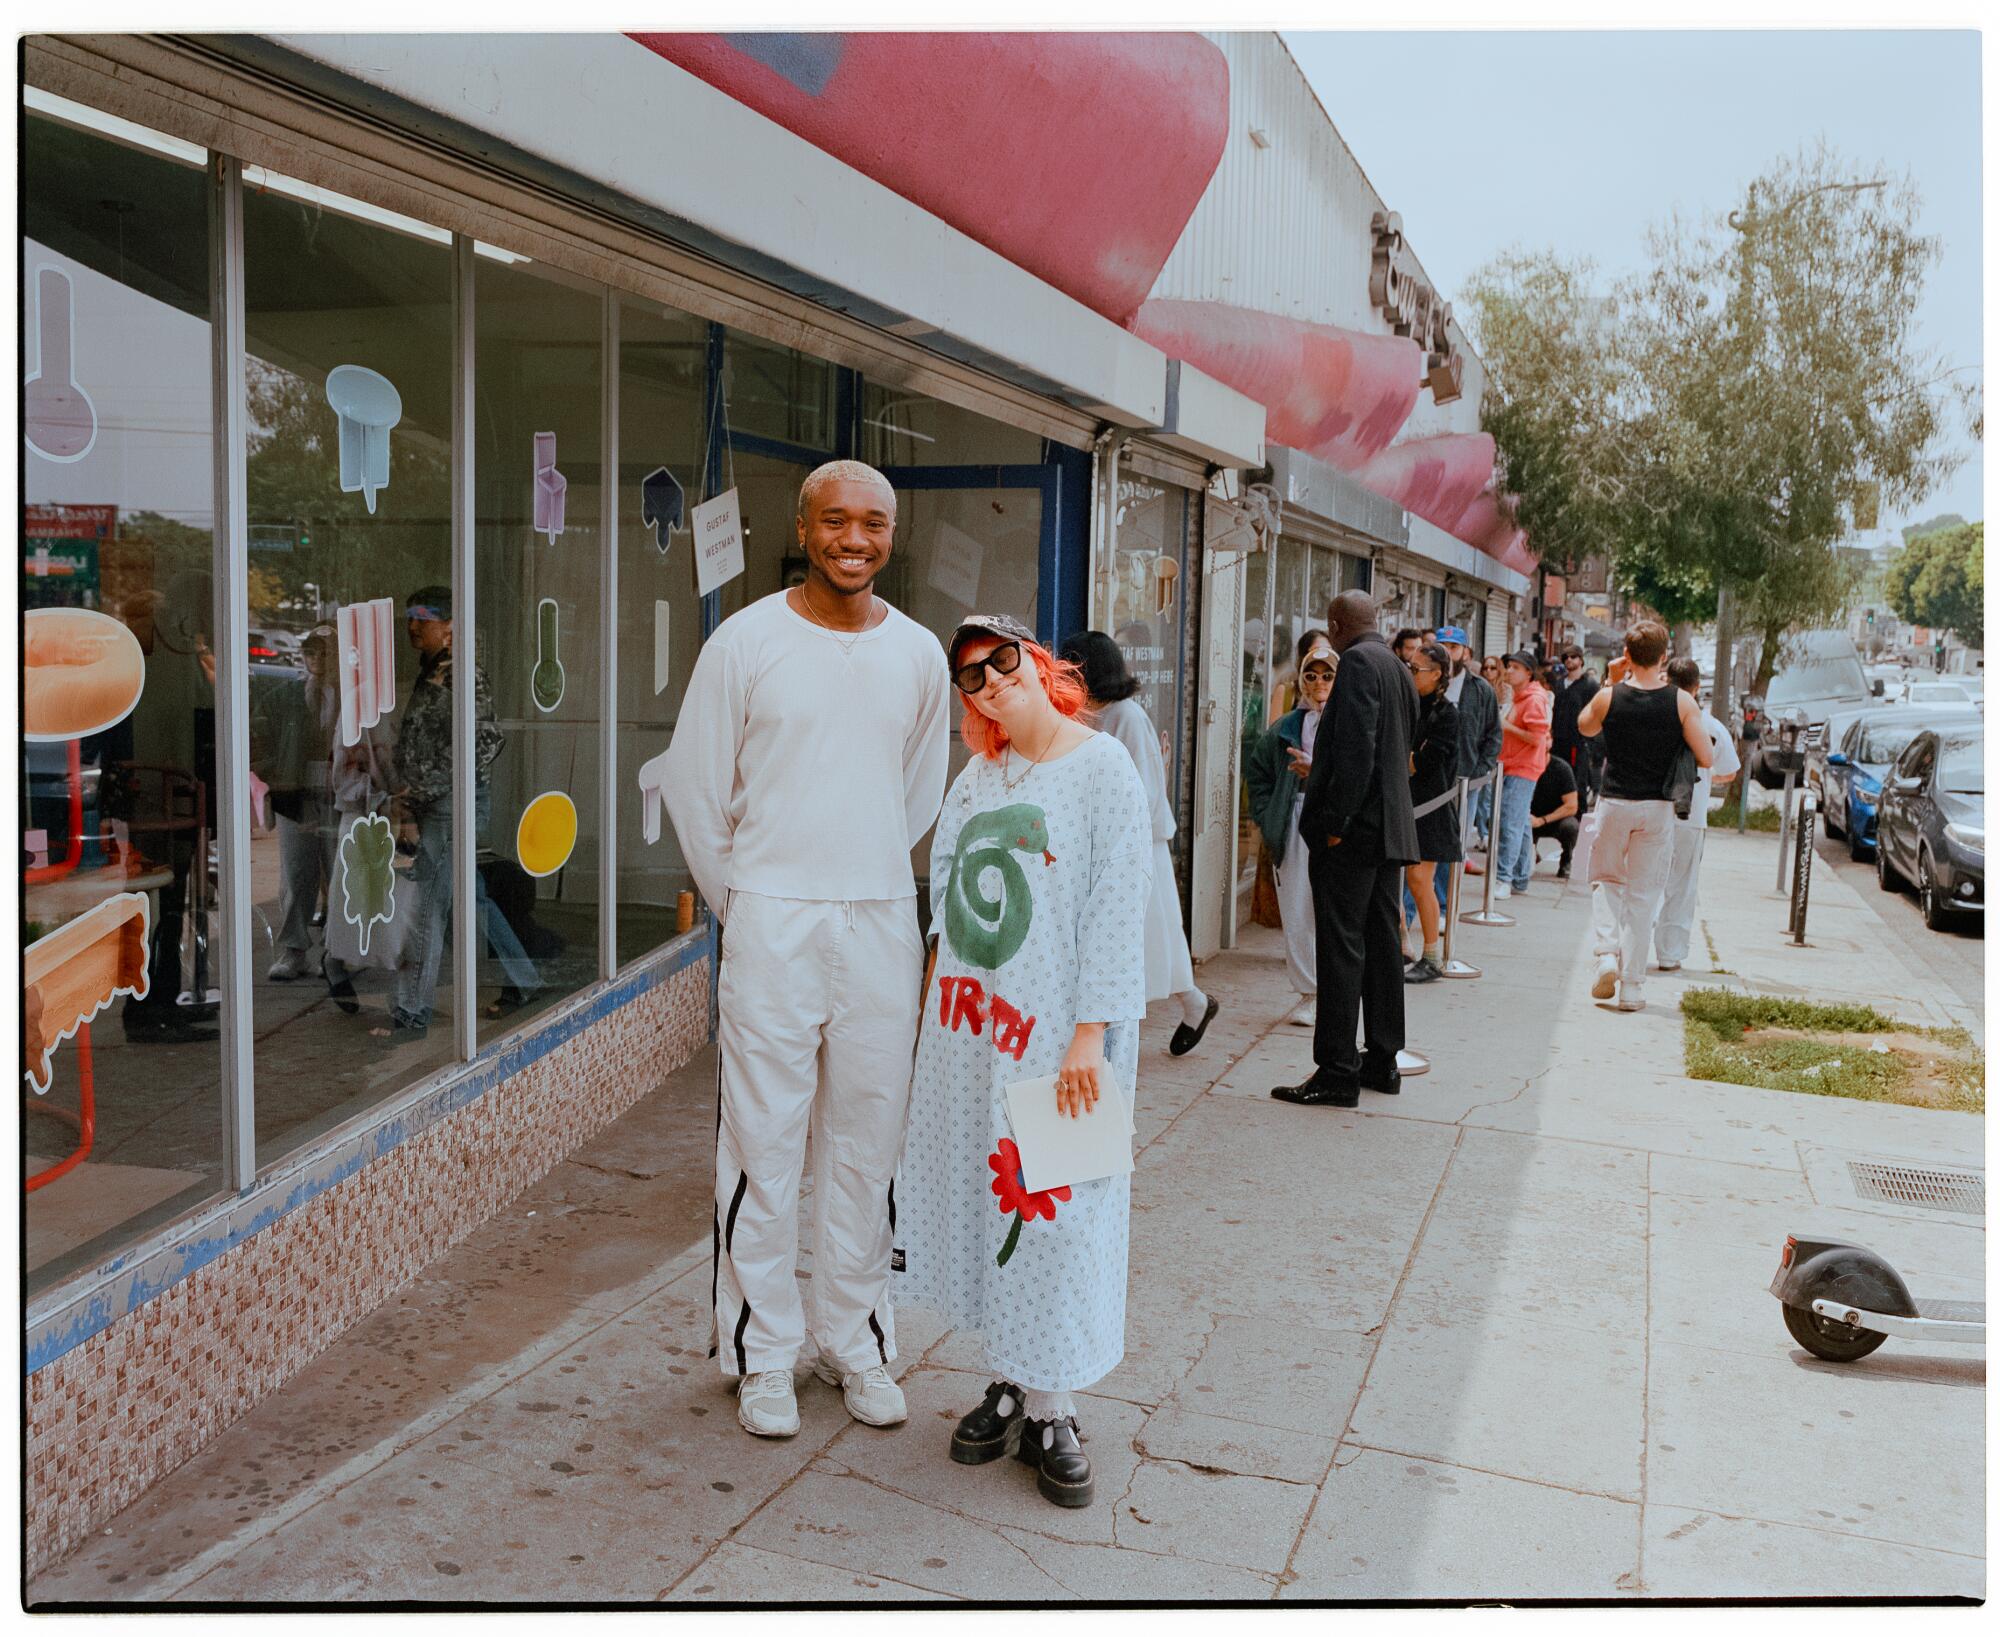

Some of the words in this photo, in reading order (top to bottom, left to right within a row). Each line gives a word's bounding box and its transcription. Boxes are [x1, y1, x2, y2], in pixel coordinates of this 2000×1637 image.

[706, 512, 730, 532] GUSTAF
[705, 534, 736, 559] WESTMAN
[1135, 647, 1164, 660] WESTMAN
[1160, 670, 1173, 684] HERE
